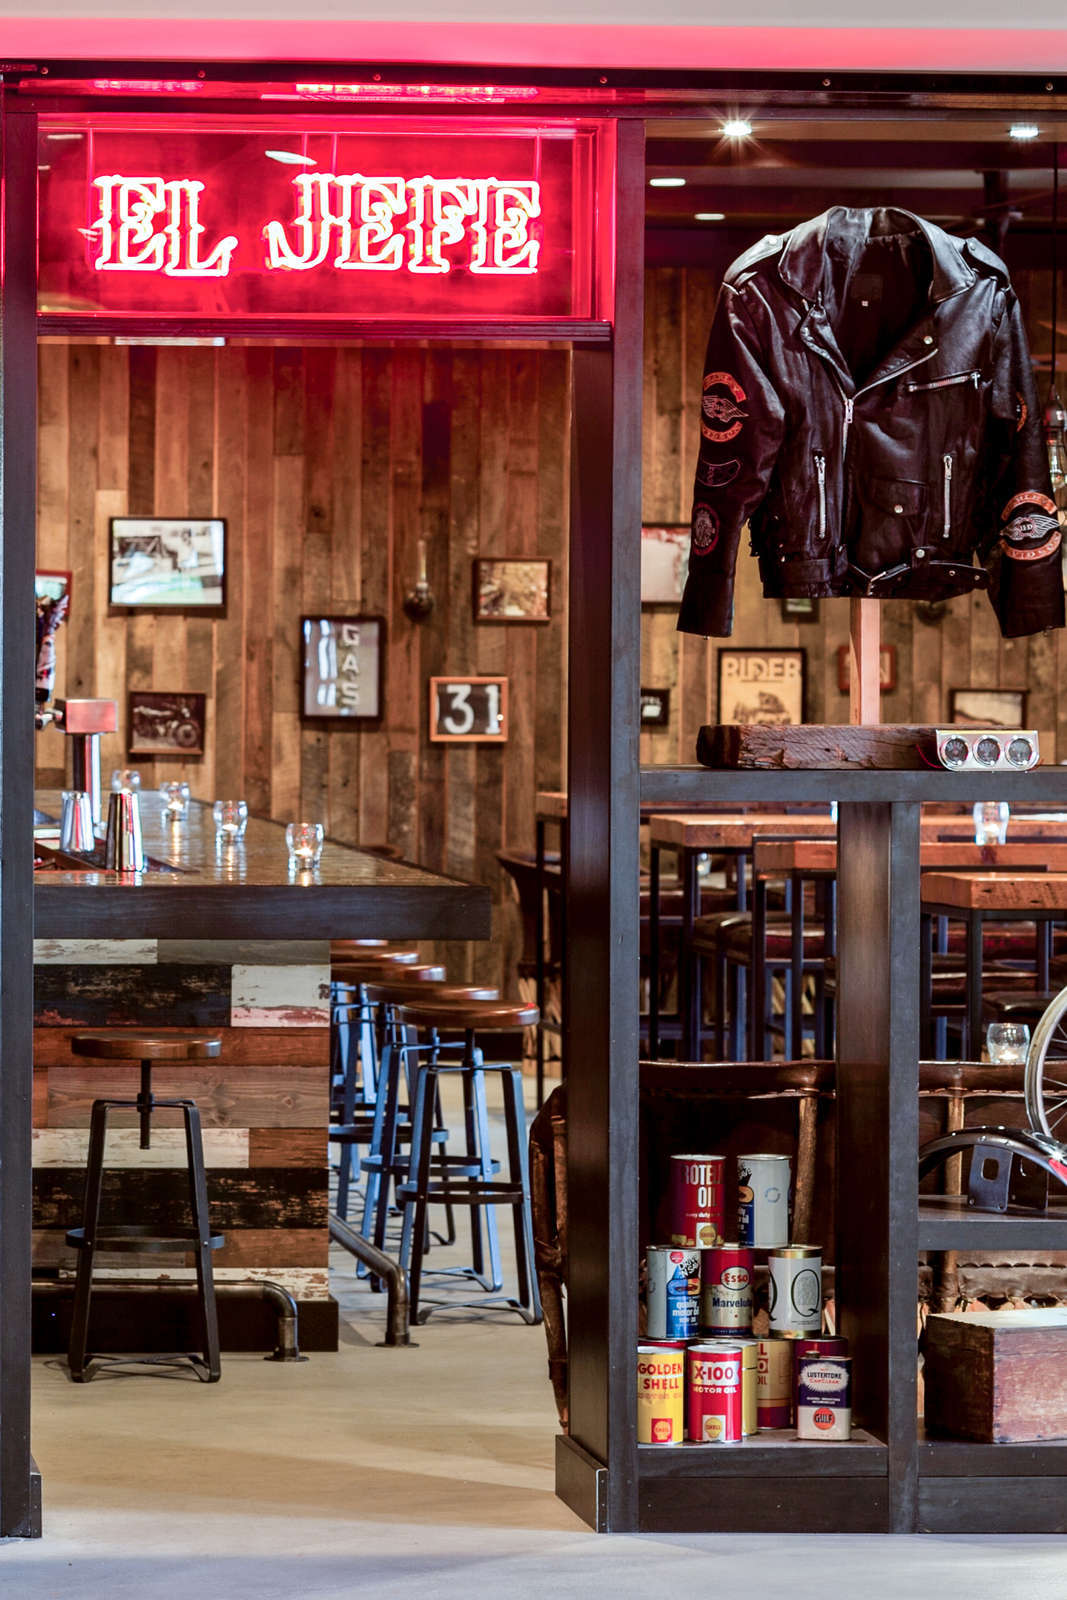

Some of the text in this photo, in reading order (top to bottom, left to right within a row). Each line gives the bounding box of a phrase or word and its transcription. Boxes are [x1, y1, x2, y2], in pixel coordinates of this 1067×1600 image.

[93, 173, 541, 277] EL JEFE
[341, 624, 361, 706] GAS
[724, 656, 802, 679] RIDER
[723, 1272, 748, 1283] Esso
[638, 1363, 683, 1375] GOLDEN
[694, 1365, 734, 1381] X-100
[643, 1378, 680, 1390] SHELL
